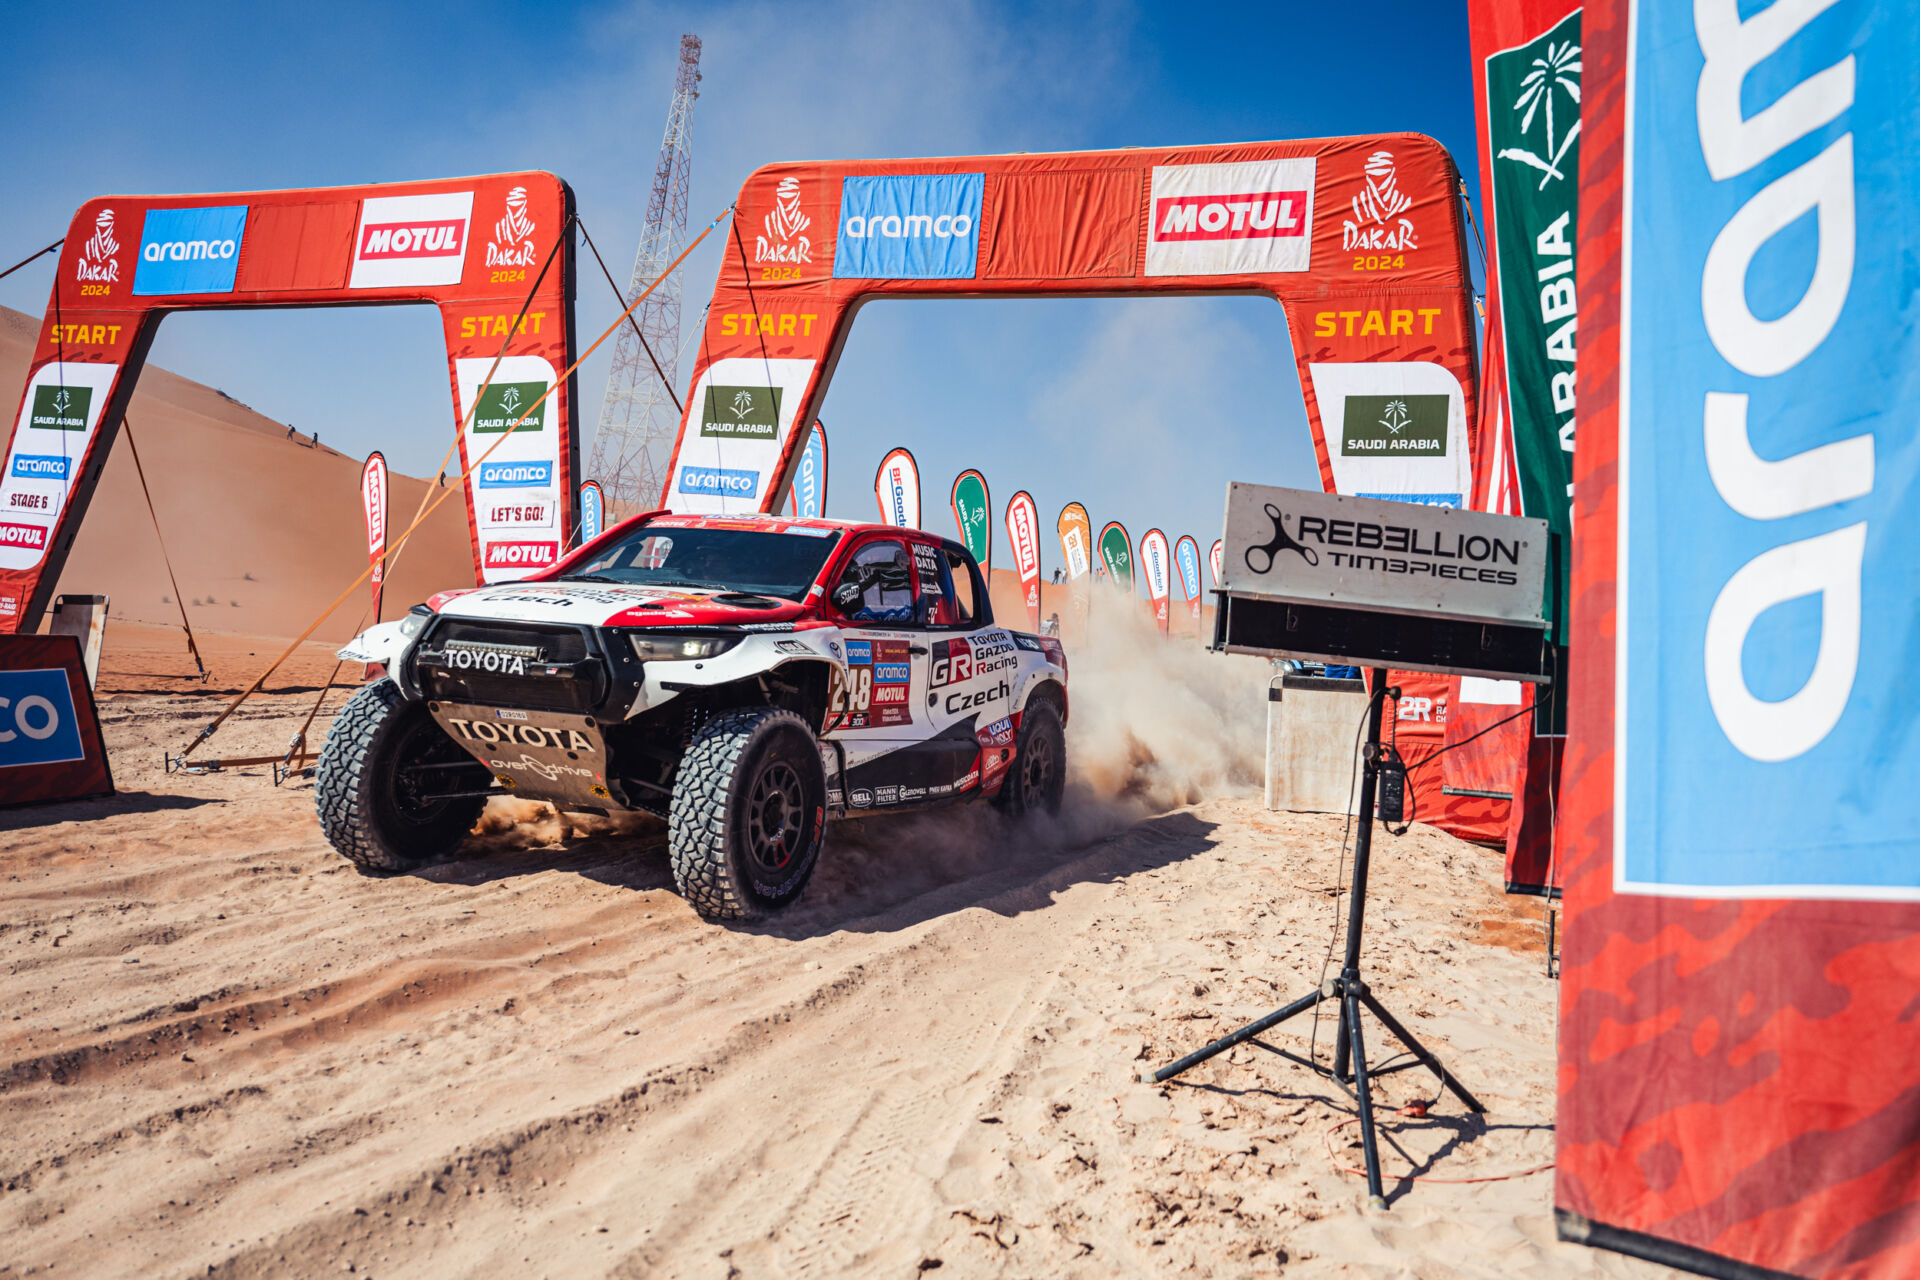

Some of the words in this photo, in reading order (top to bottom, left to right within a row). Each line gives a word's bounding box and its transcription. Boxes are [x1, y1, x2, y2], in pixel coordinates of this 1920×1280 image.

[1161, 198, 1298, 234] MOTUL
[846, 213, 972, 239] aramco
[364, 226, 457, 253] MOTUL
[1342, 219, 1417, 251] DAKAR
[144, 240, 235, 261] aramco
[485, 241, 535, 267] DAKAR
[755, 235, 812, 264] DAKAR
[77, 258, 119, 282] DAKAR
[1353, 255, 1405, 271] 2024
[490, 270, 526, 283] 2024
[761, 268, 802, 280] 2024
[80, 285, 111, 296] 2024
[461, 312, 546, 338] START
[721, 314, 818, 336] START
[1314, 308, 1441, 337] START
[50, 325, 122, 345] START
[34, 416, 55, 425] SAUDI
[56, 417, 84, 426] ARABIA
[477, 418, 504, 428] SAUDI
[505, 417, 540, 427] ARABIA
[705, 422, 735, 432] SAUDI
[736, 424, 773, 433] ARABIA
[1347, 438, 1387, 449] SAUDI
[1389, 438, 1440, 449] ARABIA
[16, 459, 66, 474] aramco
[485, 466, 547, 481] aramco
[685, 473, 751, 490] aramco
[11, 493, 43, 508] STAGE
[42, 496, 48, 509] 6
[369, 470, 381, 540] MOTUL
[491, 507, 522, 522] LET'S
[524, 506, 544, 521] GO!
[1015, 507, 1034, 571] MOTUL
[489, 546, 553, 563] MOTUL
[911, 543, 937, 558] MUSIC
[916, 557, 938, 571] DATA
[1182, 543, 1197, 594] aramco
[967, 632, 1007, 646] TOYOTA
[848, 648, 870, 657] aramco
[445, 649, 524, 675] TOYOTA
[931, 653, 971, 687] GR
[976, 656, 1018, 676] Racing
[877, 666, 908, 679] aramco
[875, 687, 905, 702] MOTUL
[945, 680, 1010, 715] Czech
[448, 719, 596, 752] TOYOTA
[852, 792, 871, 801] BELL
[876, 788, 896, 796] MANN
[877, 795, 897, 803] FILTER
